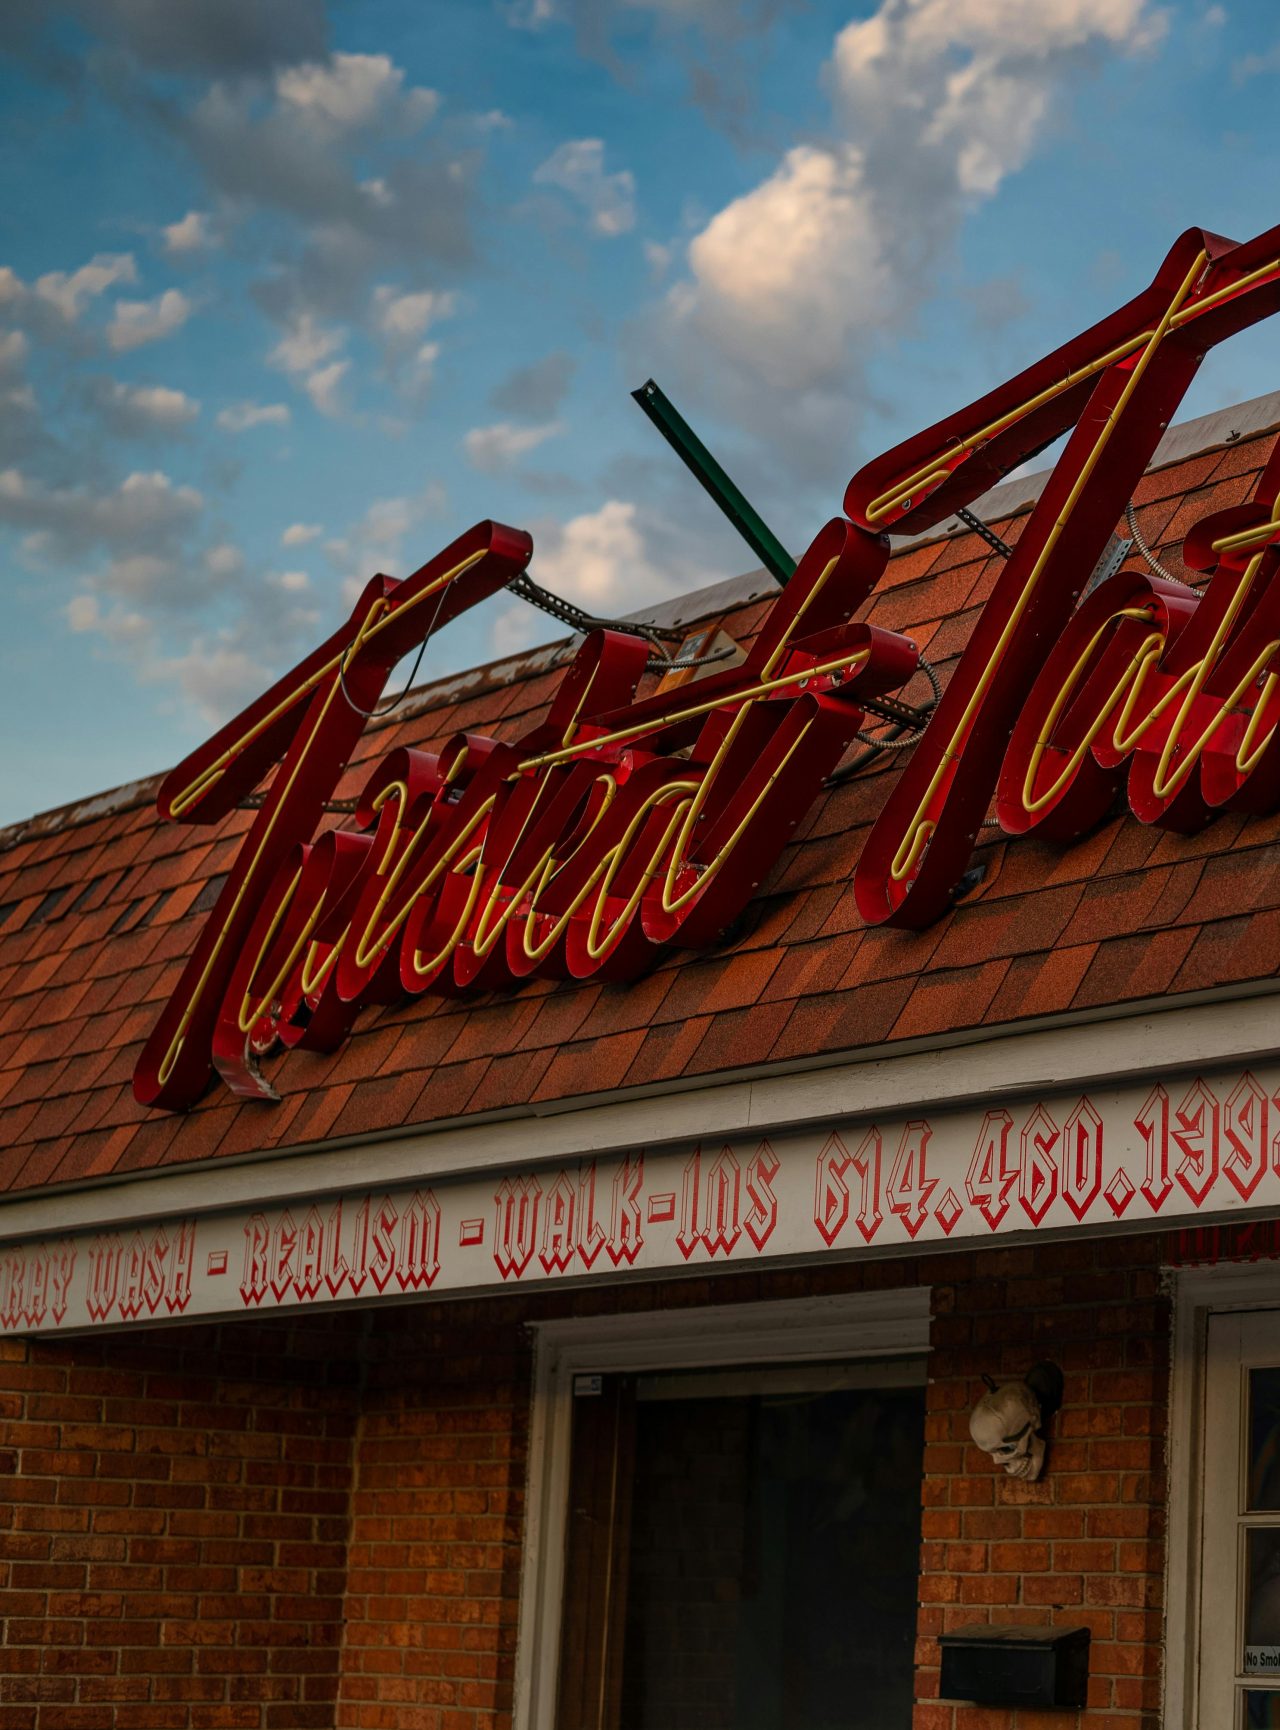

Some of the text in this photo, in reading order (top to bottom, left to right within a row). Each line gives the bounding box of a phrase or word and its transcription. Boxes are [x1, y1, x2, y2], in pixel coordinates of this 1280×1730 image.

[0, 1237, 78, 1330] RAY
[86, 1217, 197, 1322] WASH
[239, 1187, 441, 1308] REALISM
[493, 1137, 780, 1281] WALK-INS
[1246, 1651, 1258, 1666] No
